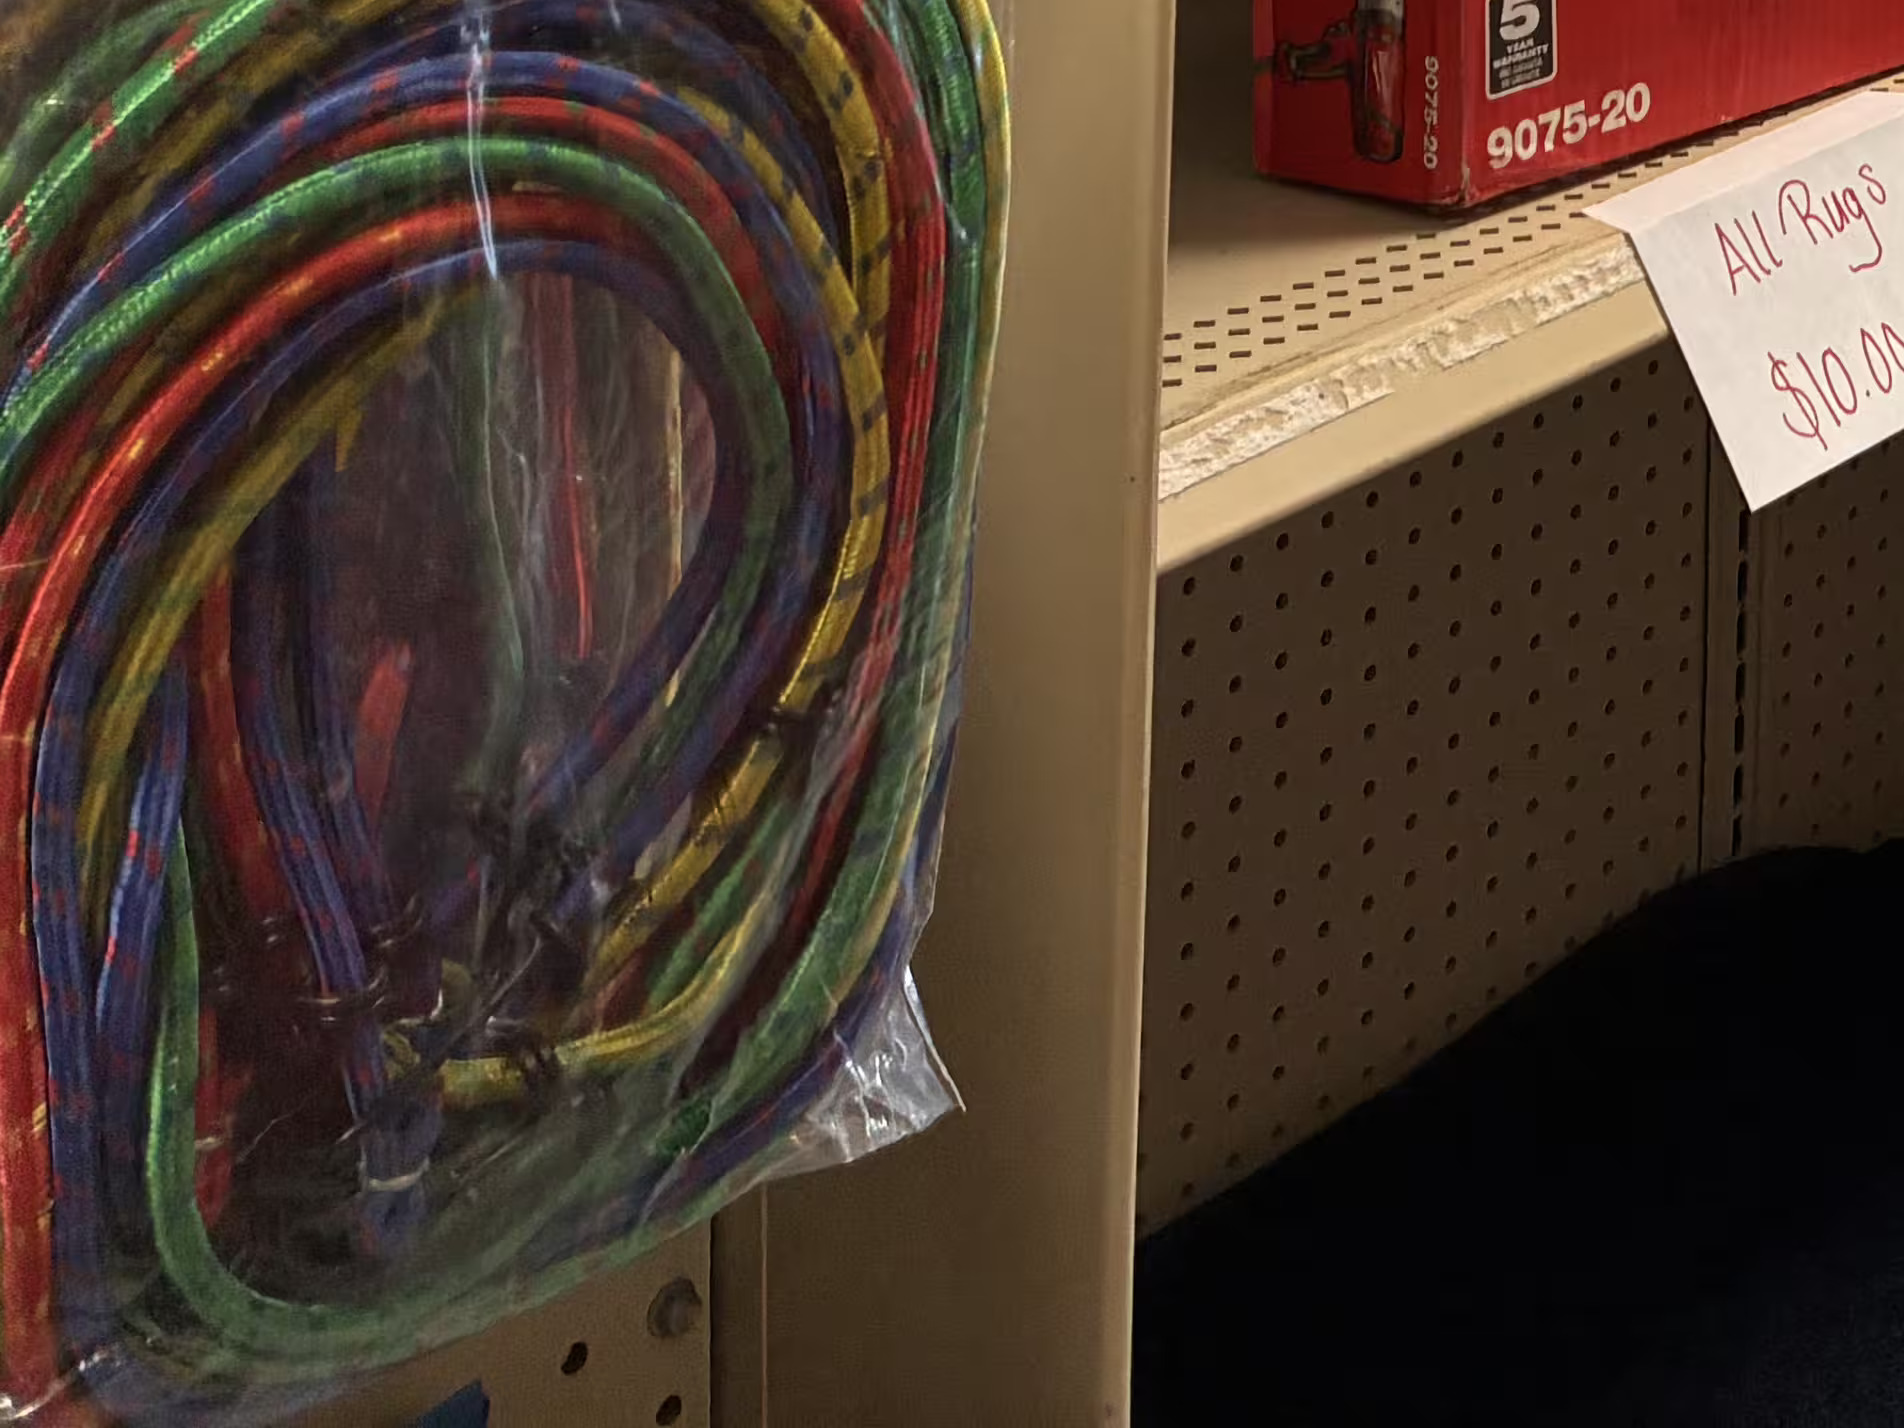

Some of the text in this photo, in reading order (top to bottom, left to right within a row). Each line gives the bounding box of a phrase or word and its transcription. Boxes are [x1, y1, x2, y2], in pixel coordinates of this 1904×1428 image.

[1492, 42, 1550, 69] WARRANTY
[1504, 36, 1535, 55] YEAR
[1422, 54, 1439, 170] 9075-20
[1486, 81, 1652, 171] 9075-20
[1714, 162, 1888, 297] All Rugs
